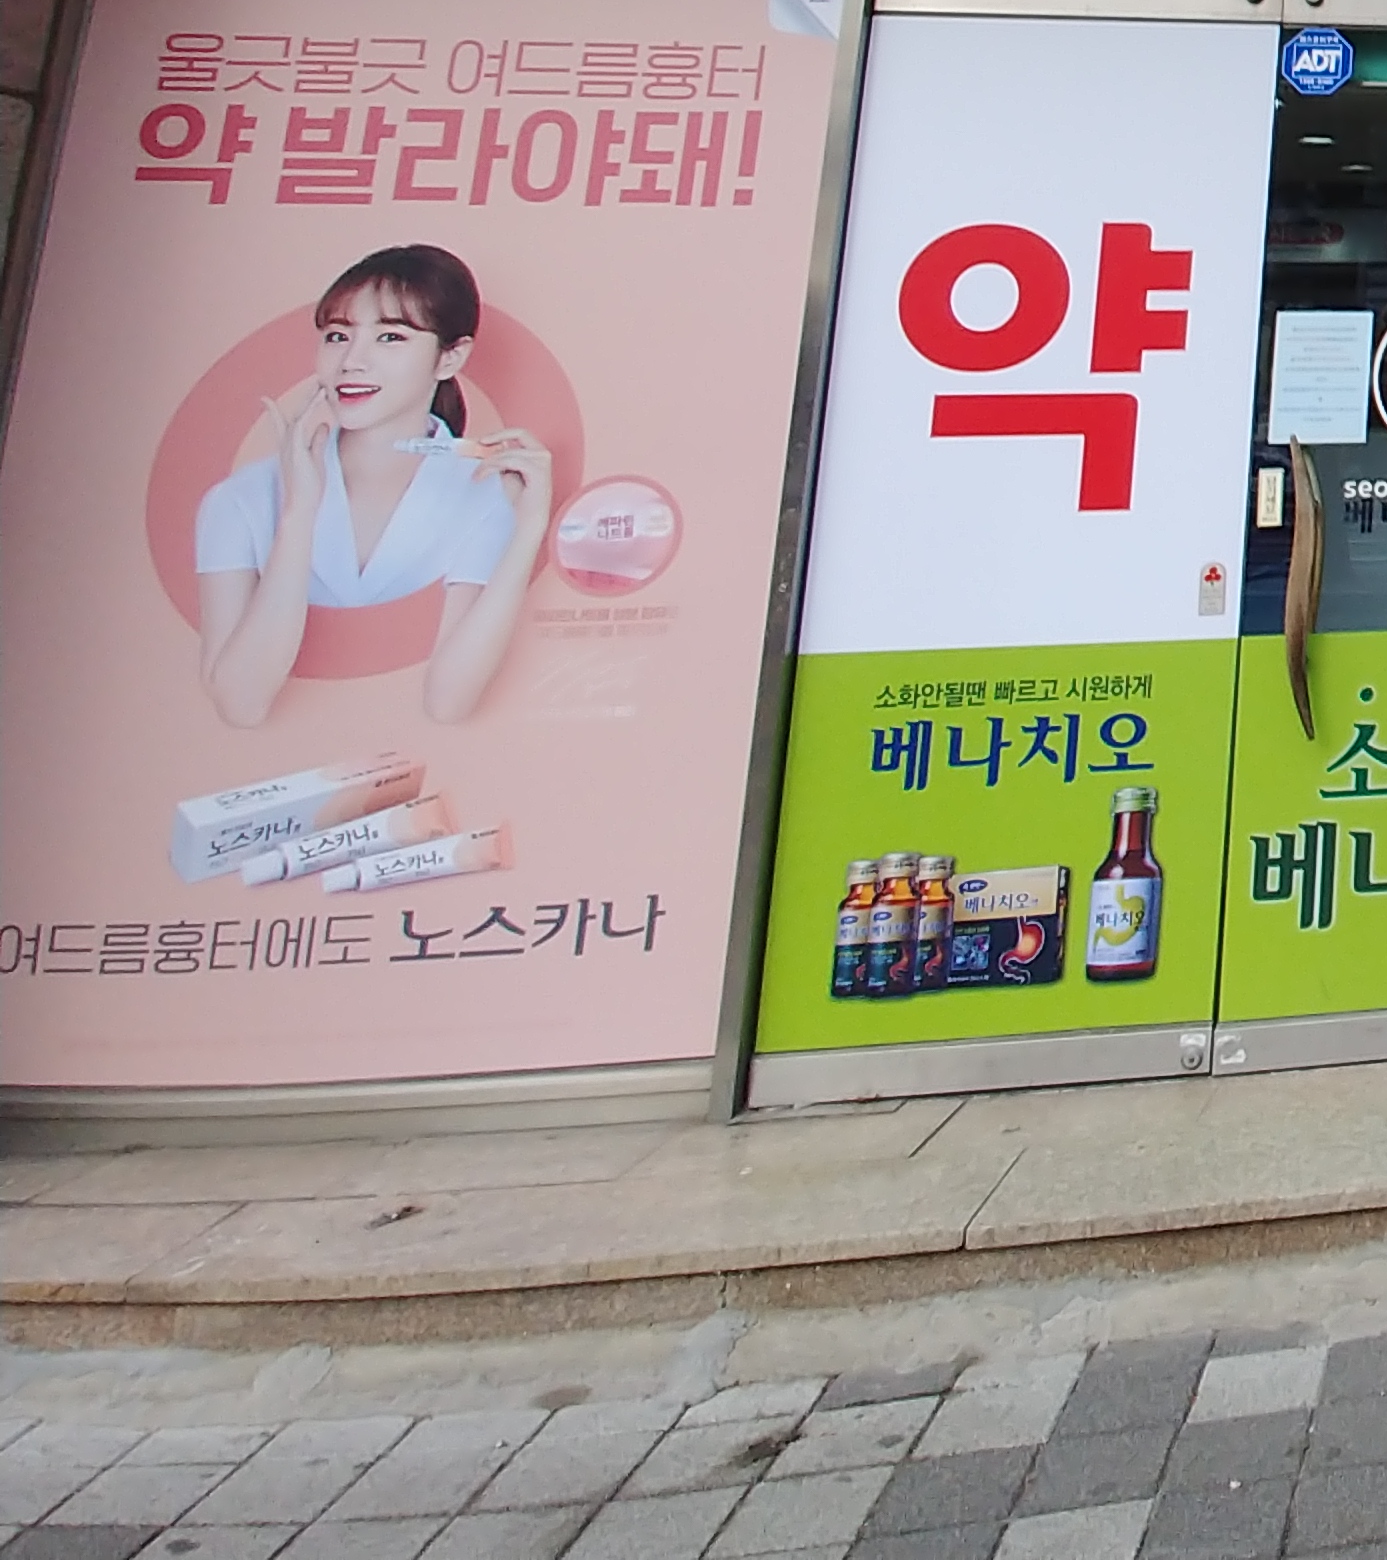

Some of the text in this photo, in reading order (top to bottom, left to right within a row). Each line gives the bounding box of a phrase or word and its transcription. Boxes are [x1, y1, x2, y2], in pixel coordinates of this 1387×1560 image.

[156, 31, 767, 103] 울긋불긋 여드름흉터
[1293, 49, 1341, 73] ADT
[134, 103, 764, 208] 약 발라야돼!
[897, 221, 1194, 512] 약
[873, 673, 1154, 710] 소화안될땐 빠르고 시원하게
[870, 712, 1155, 790] 베나치오
[0, 894, 666, 975] 여드름흉터에도 노스카나
